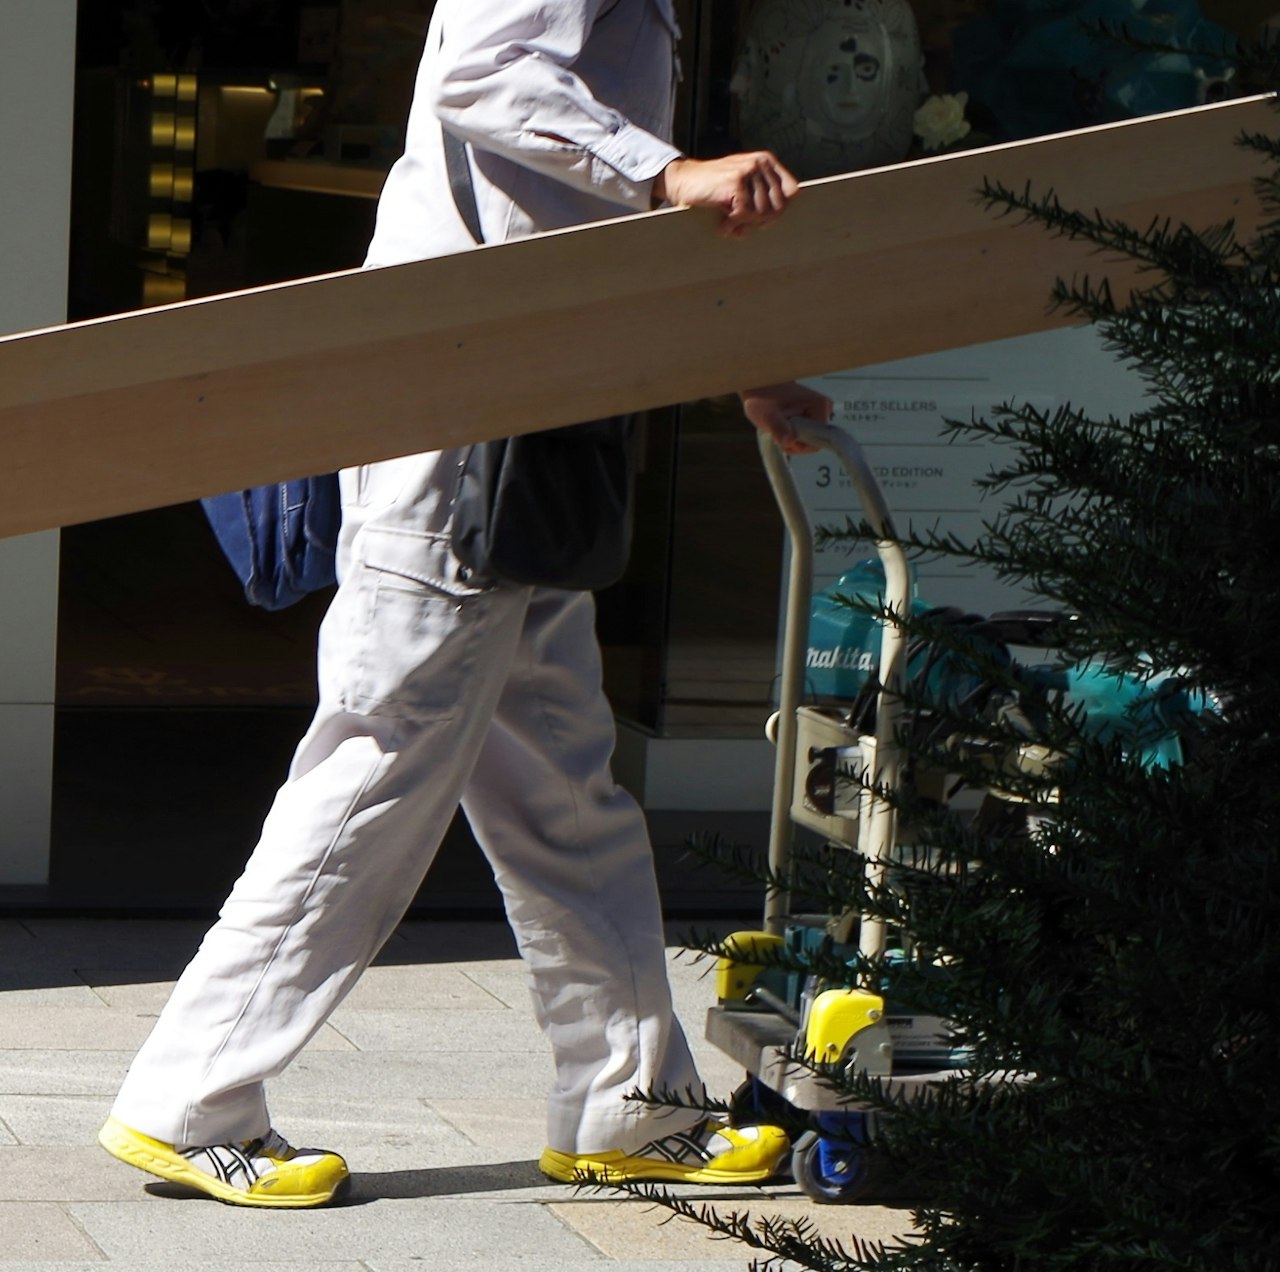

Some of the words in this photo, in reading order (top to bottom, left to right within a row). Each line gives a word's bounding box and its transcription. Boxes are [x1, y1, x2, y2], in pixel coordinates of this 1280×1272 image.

[844, 401, 877, 411] BEST
[880, 401, 937, 411] SELLERS
[816, 466, 831, 487] 3
[892, 467, 942, 477] EDITION
